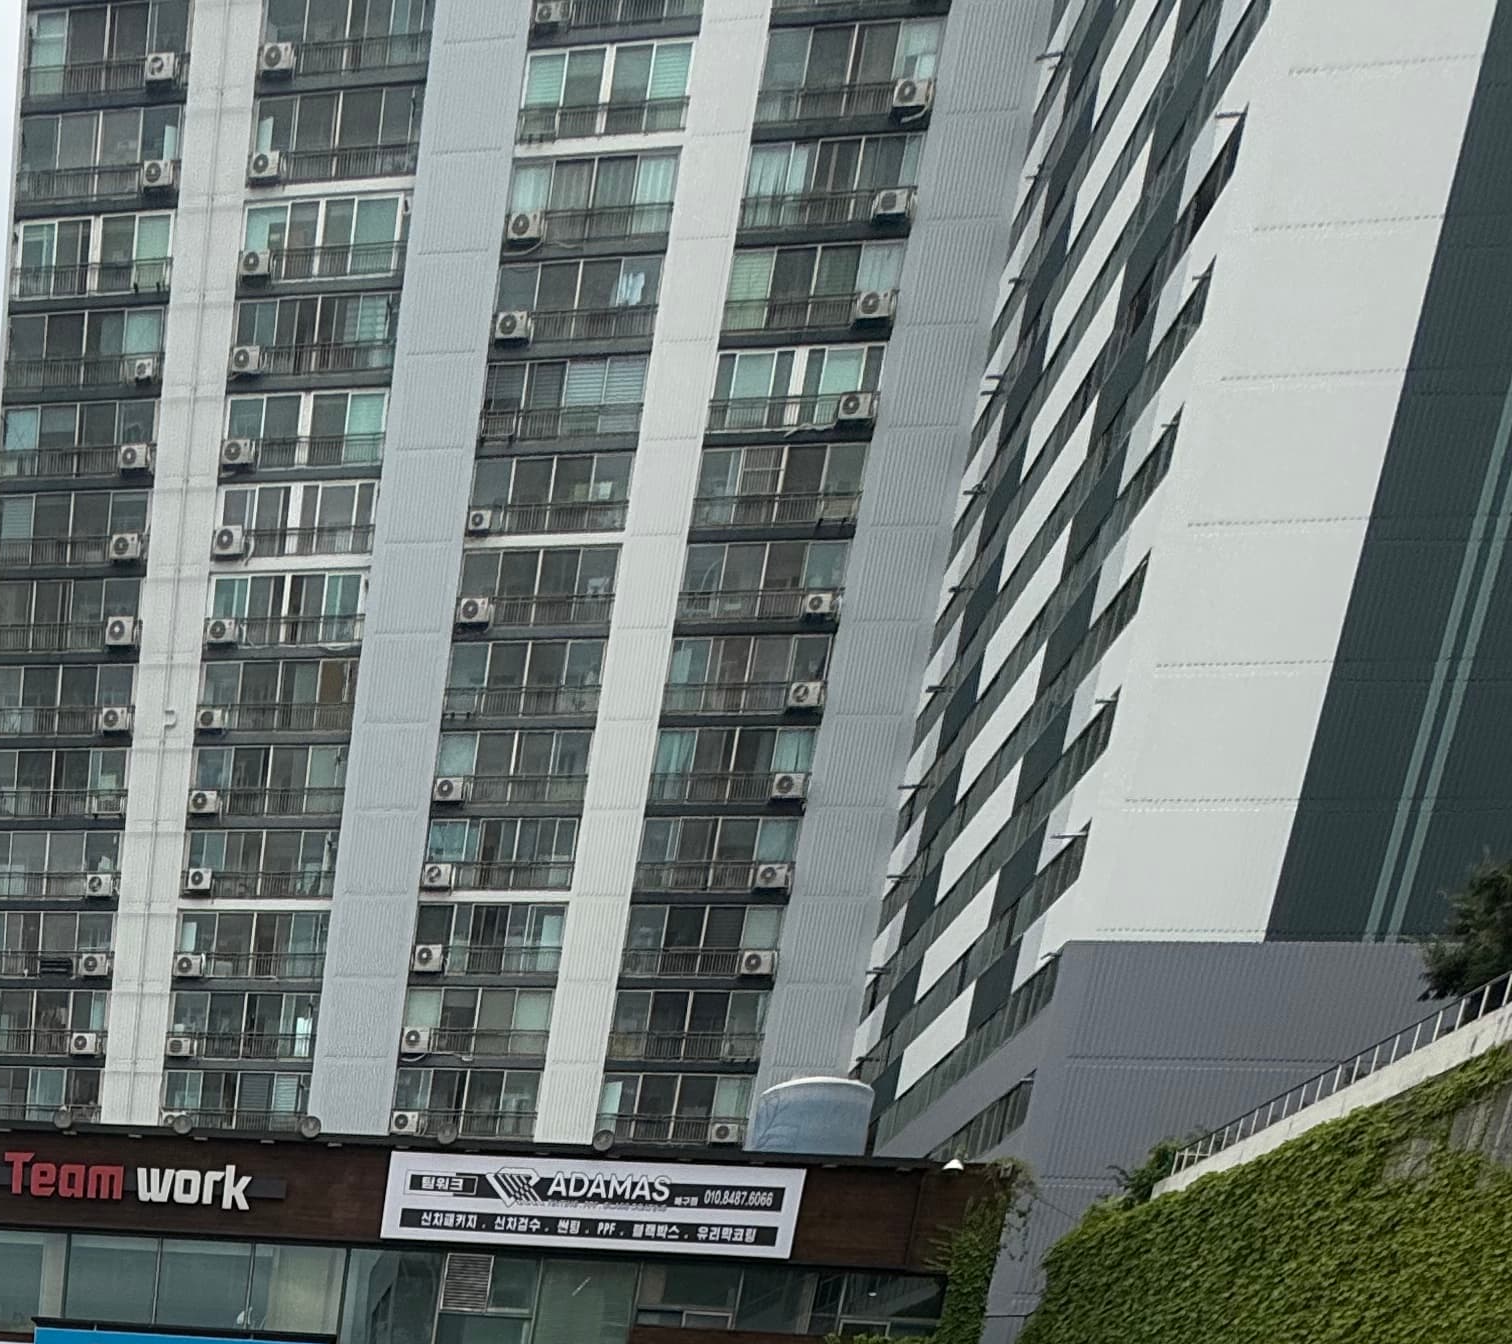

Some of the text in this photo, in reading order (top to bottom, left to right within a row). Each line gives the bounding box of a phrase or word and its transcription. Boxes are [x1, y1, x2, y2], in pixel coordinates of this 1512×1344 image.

[4, 1151, 253, 1211] Team work
[421, 1175, 464, 1192] 팀워크
[546, 1171, 672, 1202] ADAMAS
[420, 1211, 478, 1229] 신차패키지
[494, 1215, 541, 1233] 신차검수
[557, 1218, 581, 1234] 썬팅
[597, 1221, 617, 1237] PPF
[632, 1223, 680, 1240] 블랙박스
